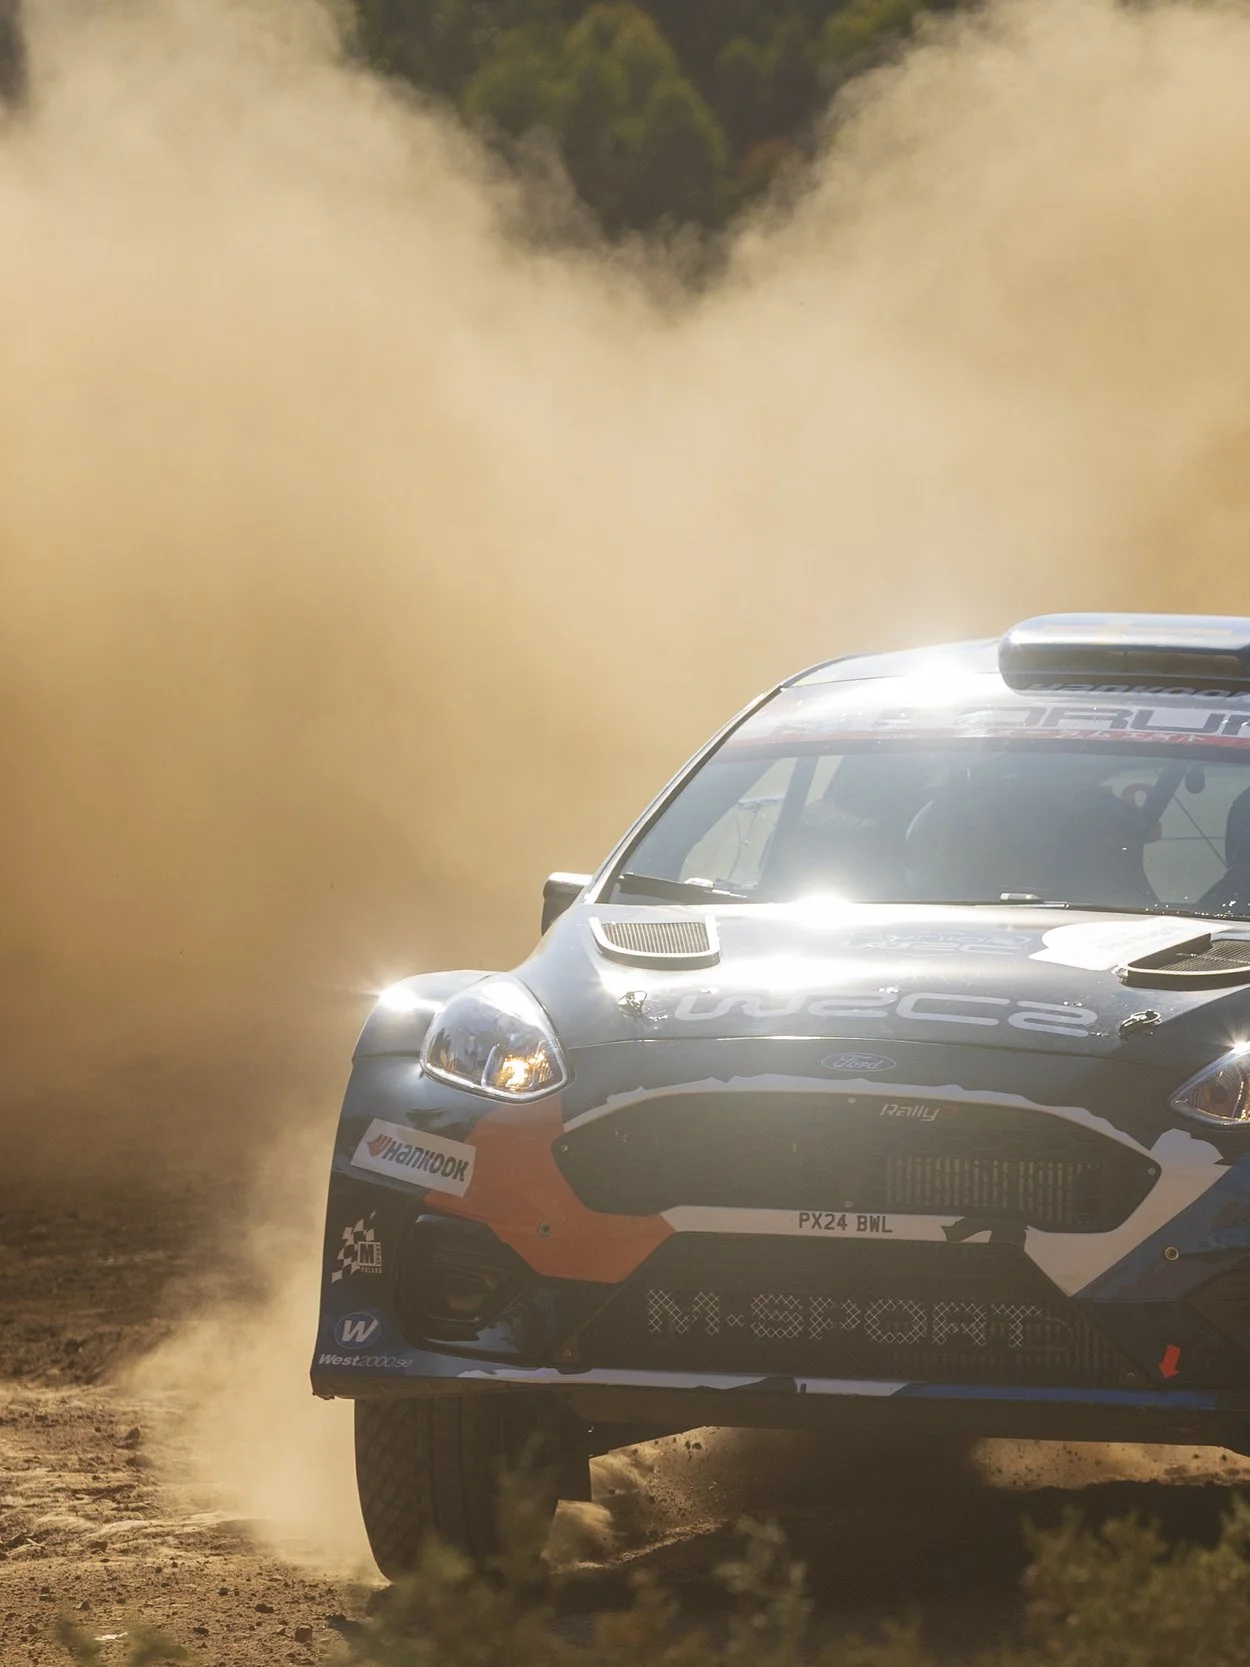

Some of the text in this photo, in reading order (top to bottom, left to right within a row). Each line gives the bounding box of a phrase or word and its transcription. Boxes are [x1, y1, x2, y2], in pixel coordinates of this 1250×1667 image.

[832, 1055, 884, 1071] Ford
[798, 1212, 893, 1234] PX24 BWL
[648, 1288, 1043, 1348] M-SPORT
[341, 1319, 379, 1343] W
